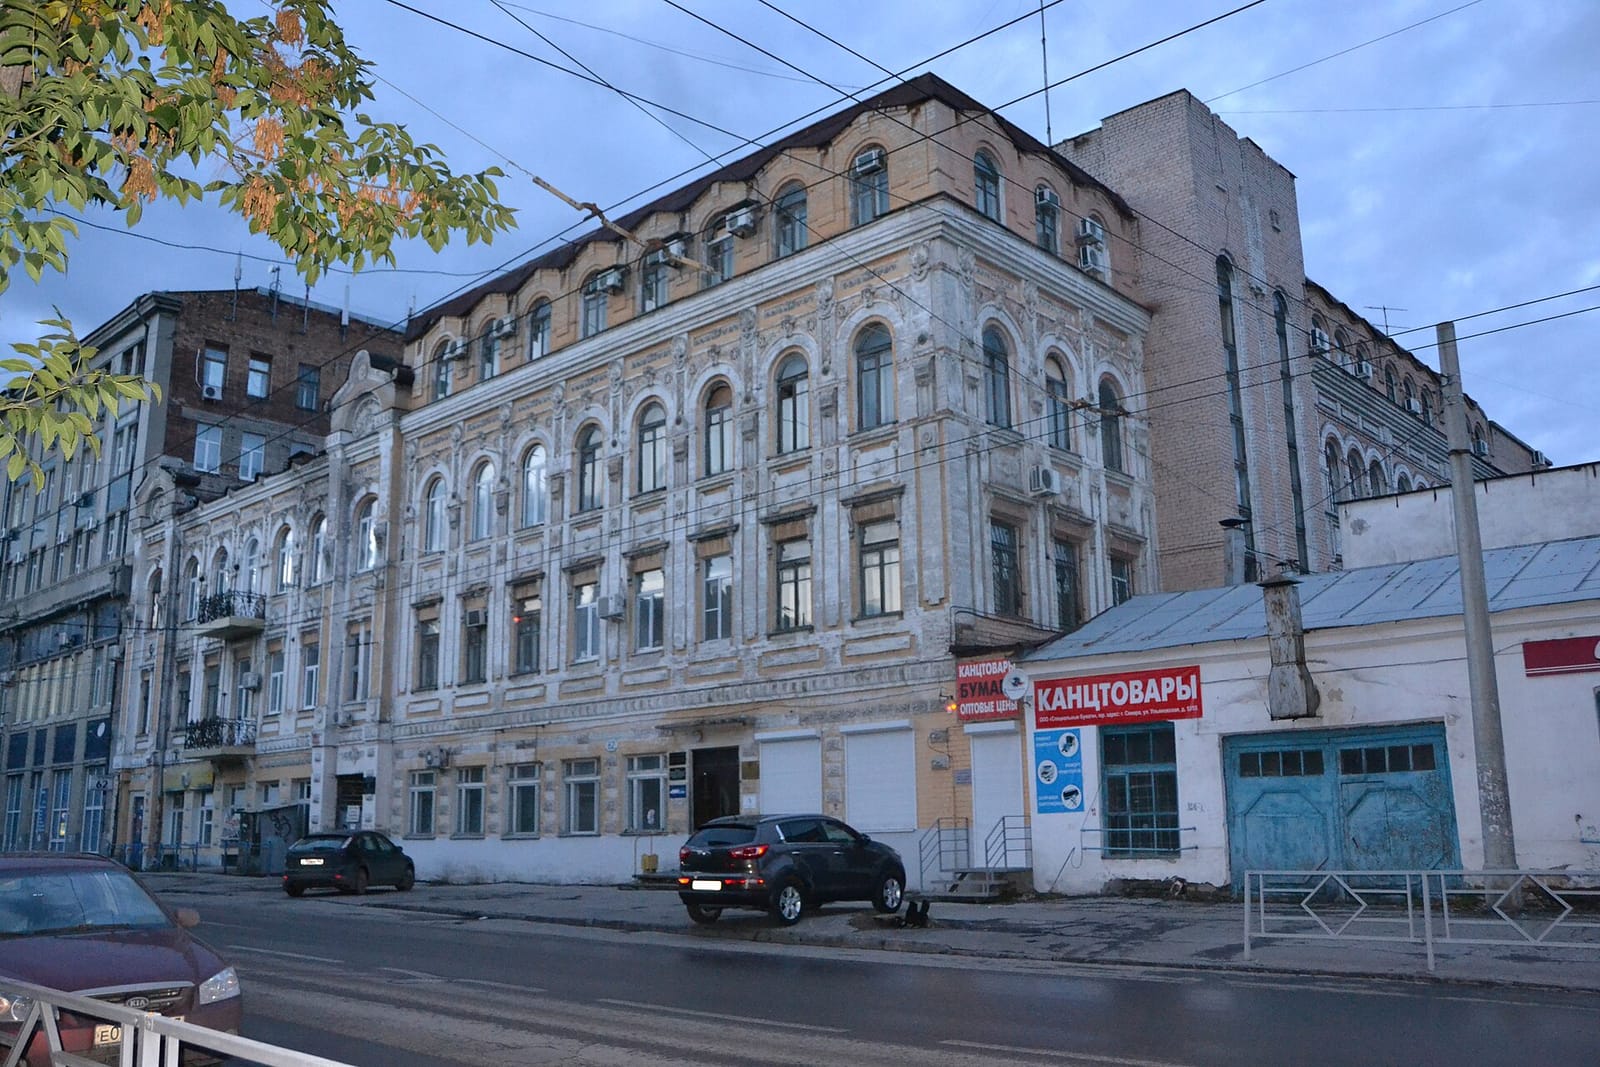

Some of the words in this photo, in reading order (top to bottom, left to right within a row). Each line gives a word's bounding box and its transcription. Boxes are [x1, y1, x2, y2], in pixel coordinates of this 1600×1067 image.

[959, 660, 1016, 678] КАНЦТОВАРЫ
[960, 680, 1004, 699] БУМА
[1037, 674, 1198, 712] КАНЦТОВАРЫ
[960, 701, 995, 715] ОПТОВЫЕ
[996, 699, 1018, 713] ЦЕНЫ
[130, 999, 147, 1008] KIA
